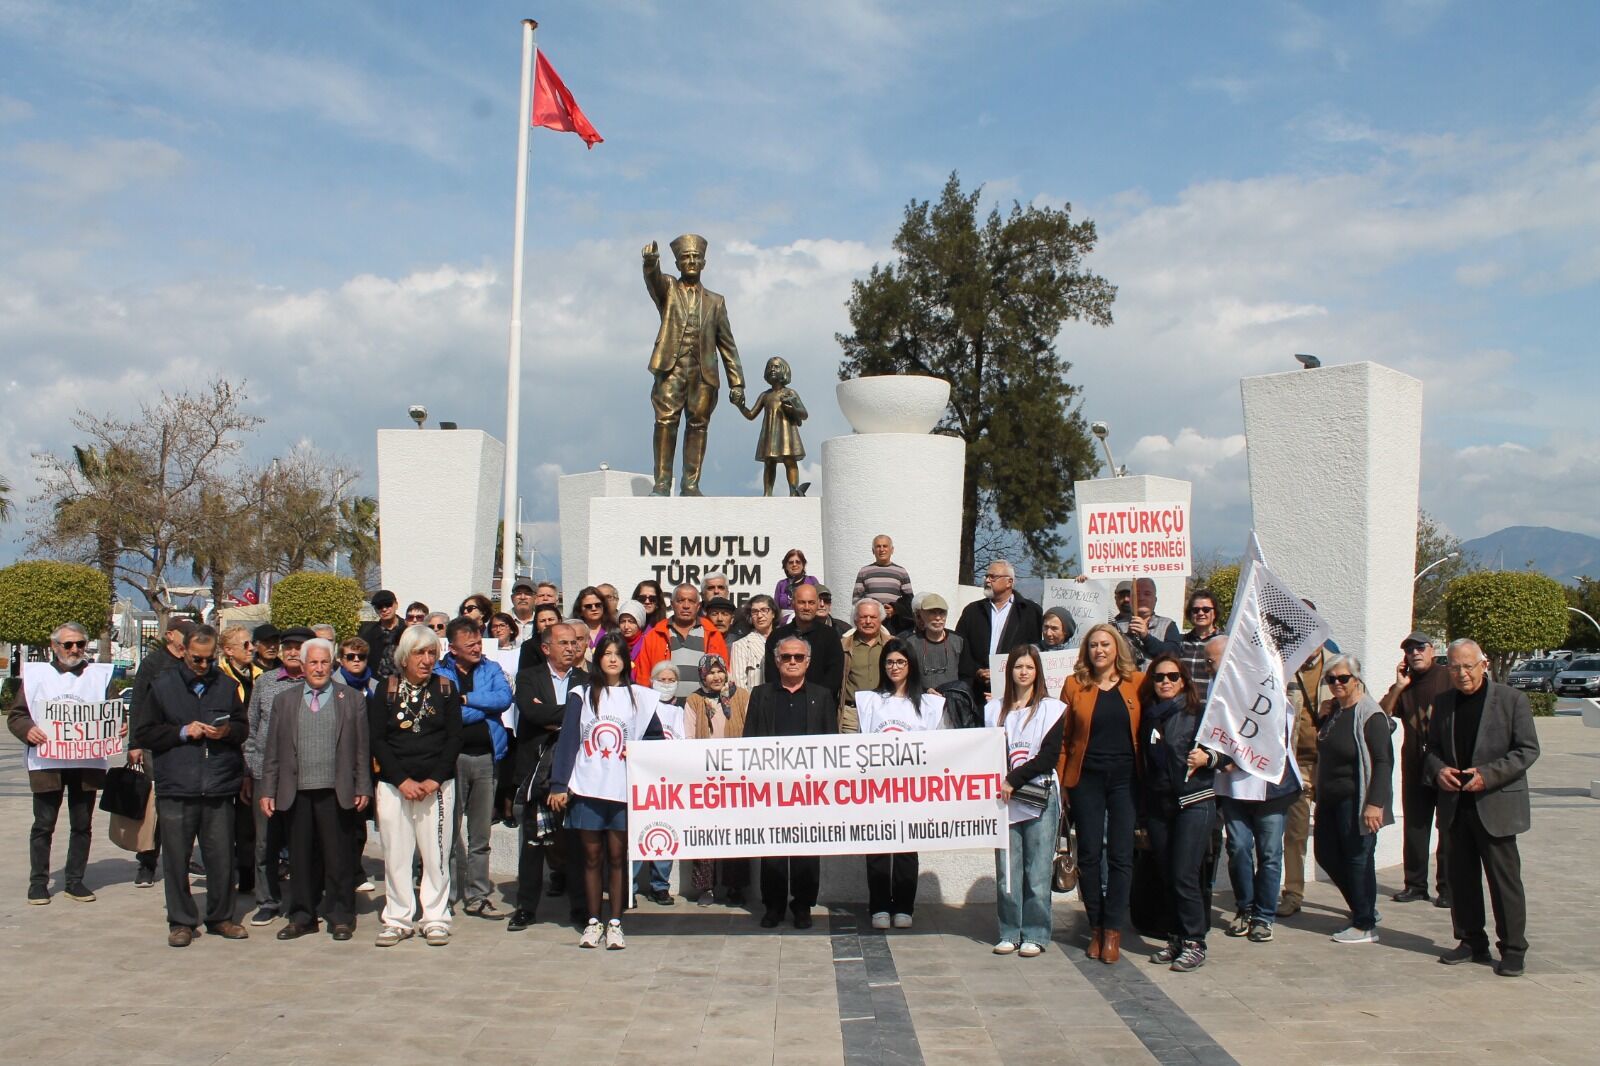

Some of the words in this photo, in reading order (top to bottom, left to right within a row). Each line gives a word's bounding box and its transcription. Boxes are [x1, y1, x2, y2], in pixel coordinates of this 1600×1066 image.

[1087, 505, 1184, 538] ATATÜRKÇÜ
[640, 536, 673, 556] NE
[681, 536, 770, 557] MUTLU
[1087, 540, 1138, 563] DÜŞÜNCE
[1140, 536, 1186, 558] DERNEĞİ
[651, 559, 761, 585] TÜRKÜM
[1091, 563, 1139, 573] FETHİYE
[1143, 562, 1184, 573] ŞUBESİ
[706, 748, 733, 771] NE
[737, 741, 818, 771] TARİKAT
[823, 745, 851, 769] NE
[856, 737, 927, 773] ŞERİAT:
[632, 776, 685, 811] LAİK
[689, 775, 772, 809] EĞİTİM
[776, 773, 830, 807] LAİK
[834, 767, 1002, 805] CUMHURİYET!
[683, 825, 732, 847] TÜRKİYE
[735, 828, 765, 845] HALK
[768, 822, 846, 845] TEMSİLCİLERİ
[850, 819, 896, 842] MECLİSİ
[908, 816, 998, 840] MUĞLA/FETHİYE
